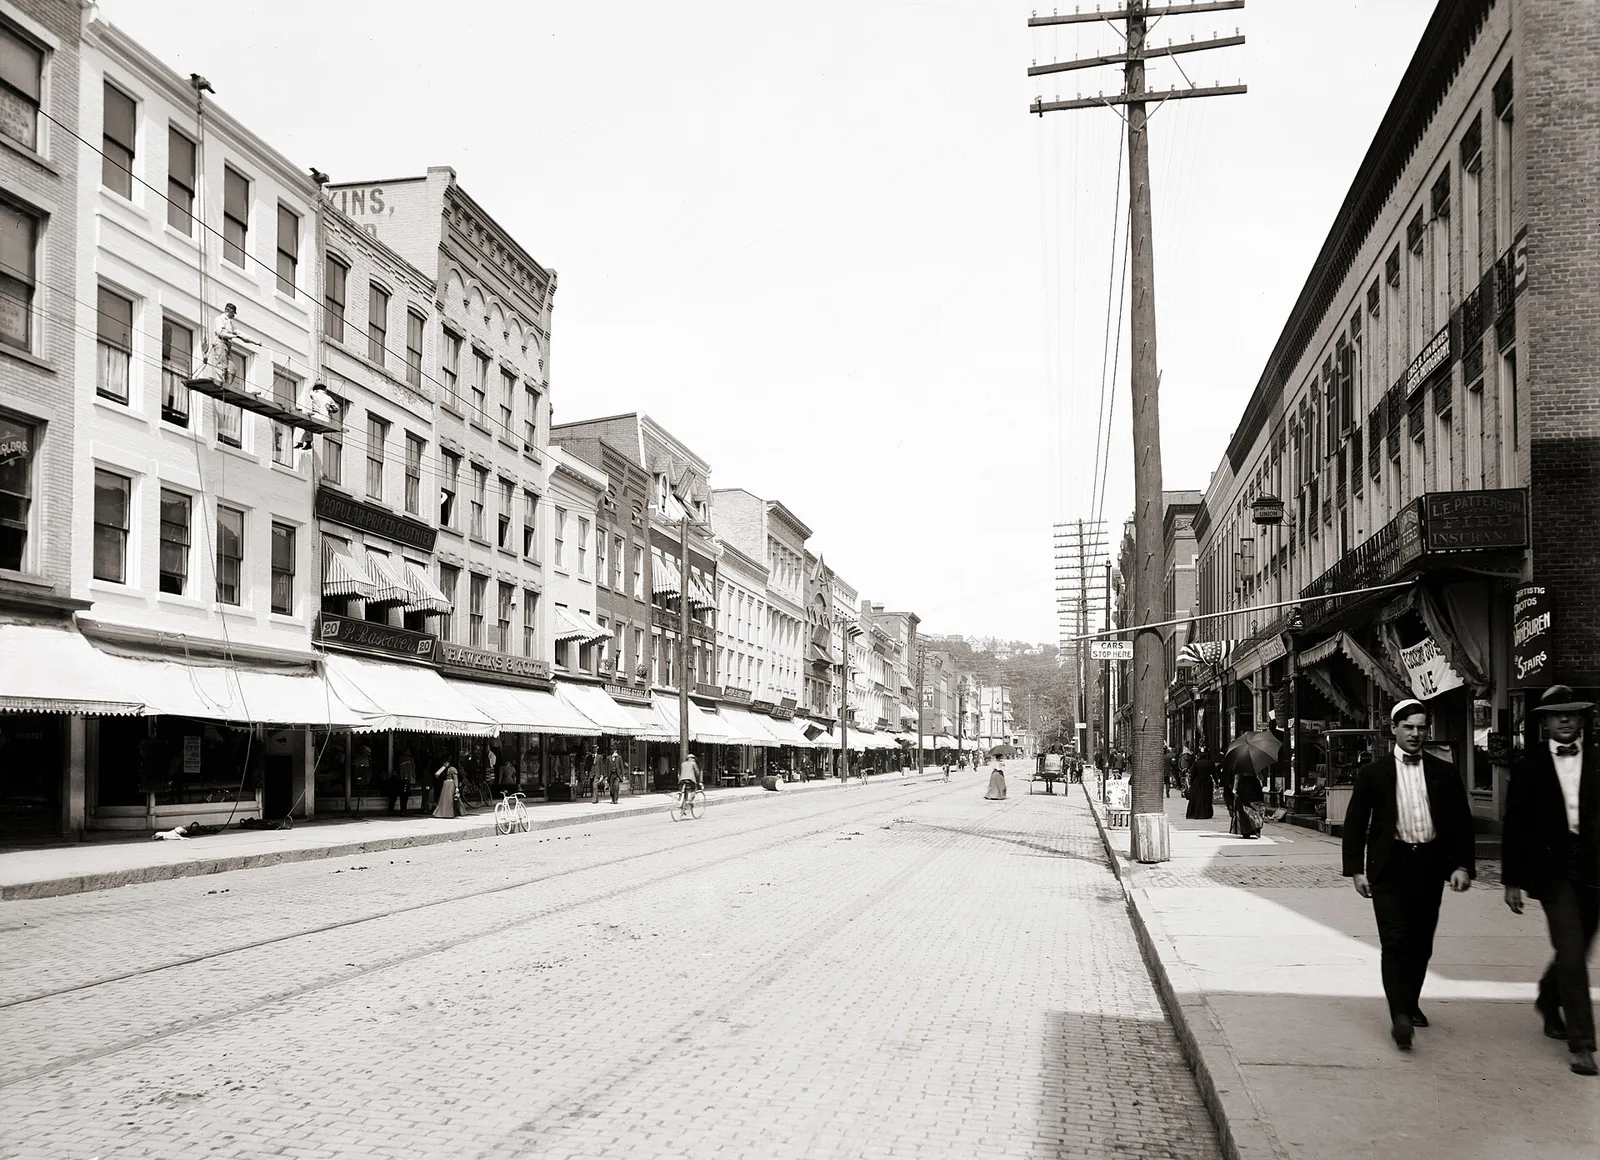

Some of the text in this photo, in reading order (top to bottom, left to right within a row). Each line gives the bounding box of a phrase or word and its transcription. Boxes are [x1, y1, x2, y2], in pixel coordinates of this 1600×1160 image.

[1442, 515, 1512, 529] FIRE
[323, 622, 338, 635] 20
[419, 640, 430, 652] 20
[1101, 642, 1124, 650] CARS
[447, 647, 503, 671] HAWKINS
[505, 657, 514, 672] &
